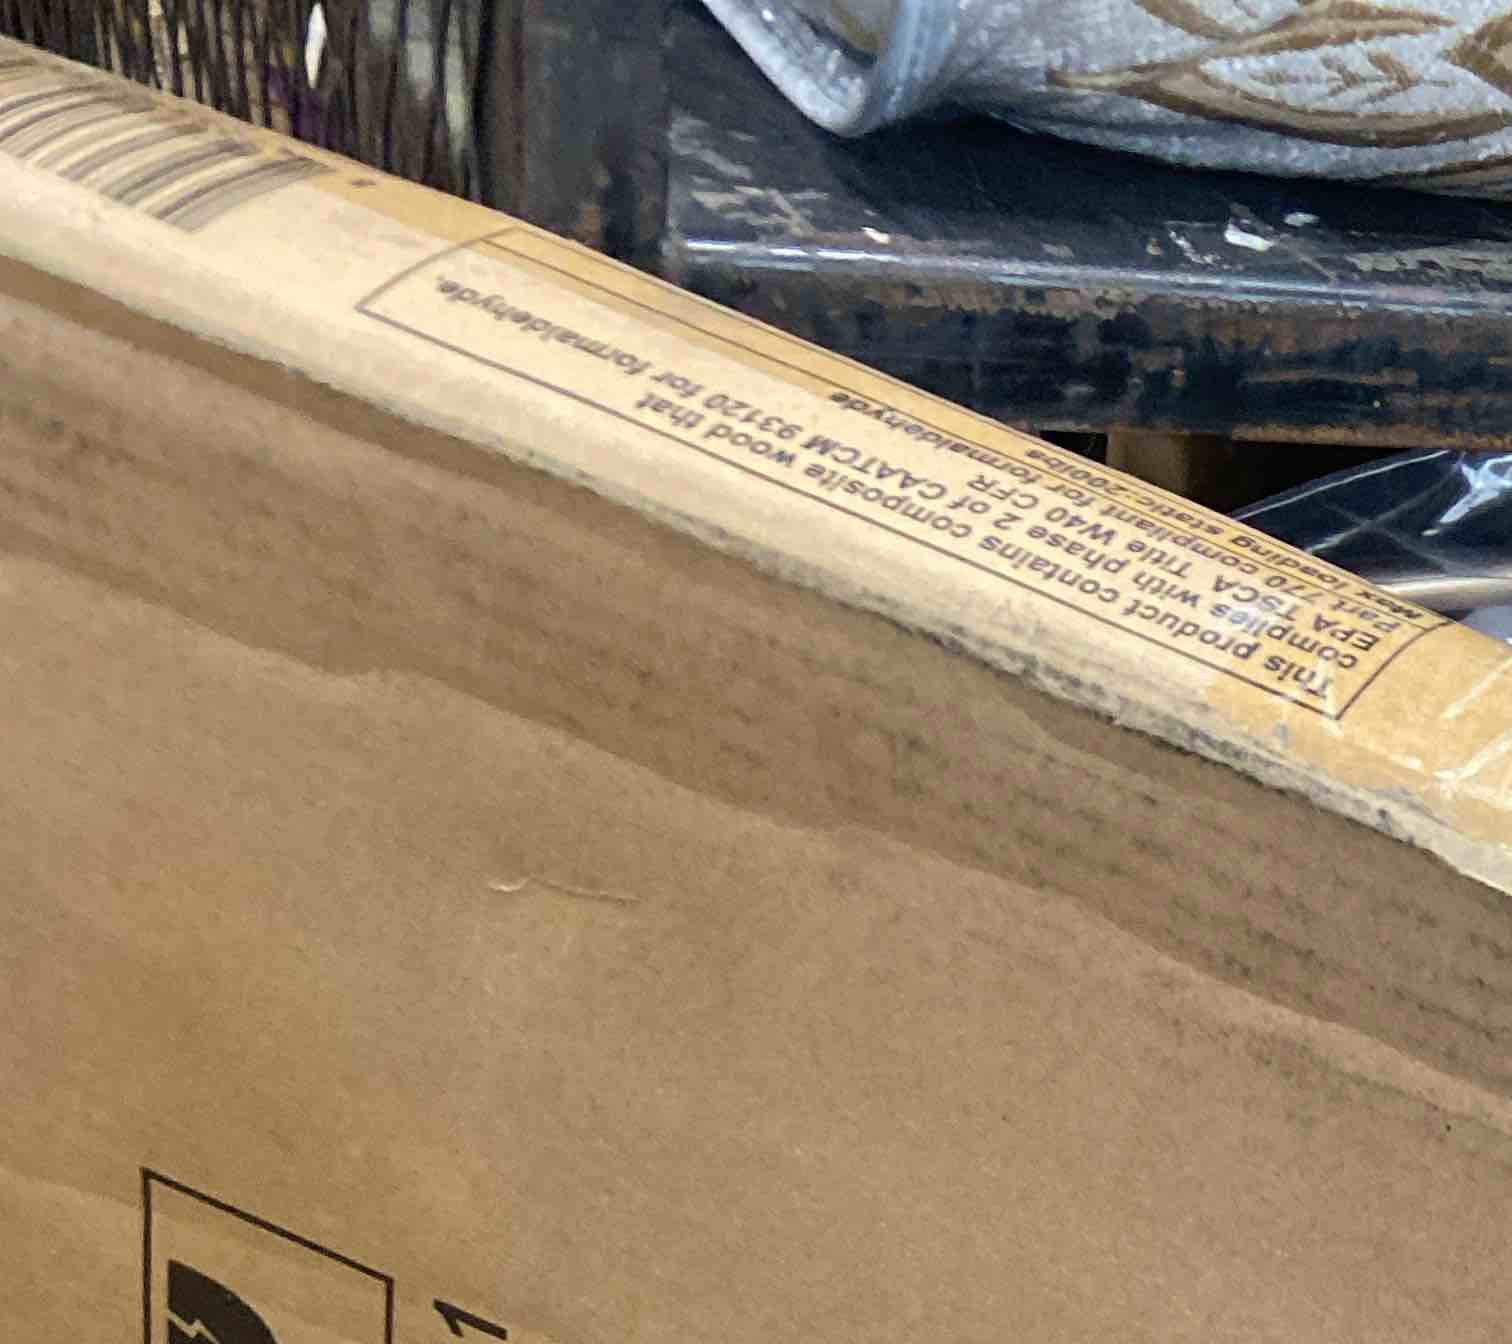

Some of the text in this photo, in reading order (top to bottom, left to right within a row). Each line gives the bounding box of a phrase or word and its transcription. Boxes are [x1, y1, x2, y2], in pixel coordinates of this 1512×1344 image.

[650, 373, 704, 397] for
[703, 394, 802, 437] 93120
[831, 391, 1400, 632] Part 770 compliant for formaldehyde
[947, 495, 991, 514] of
[994, 512, 1023, 531] 2
[636, 393, 1332, 699] This product contains composite wood that
[967, 474, 1380, 652] EPA TSCA Title W40 CFR
[1027, 526, 1128, 575] phase
[1231, 531, 1360, 593] loading
[1133, 571, 1203, 608] with
[1211, 602, 1359, 669] complies
